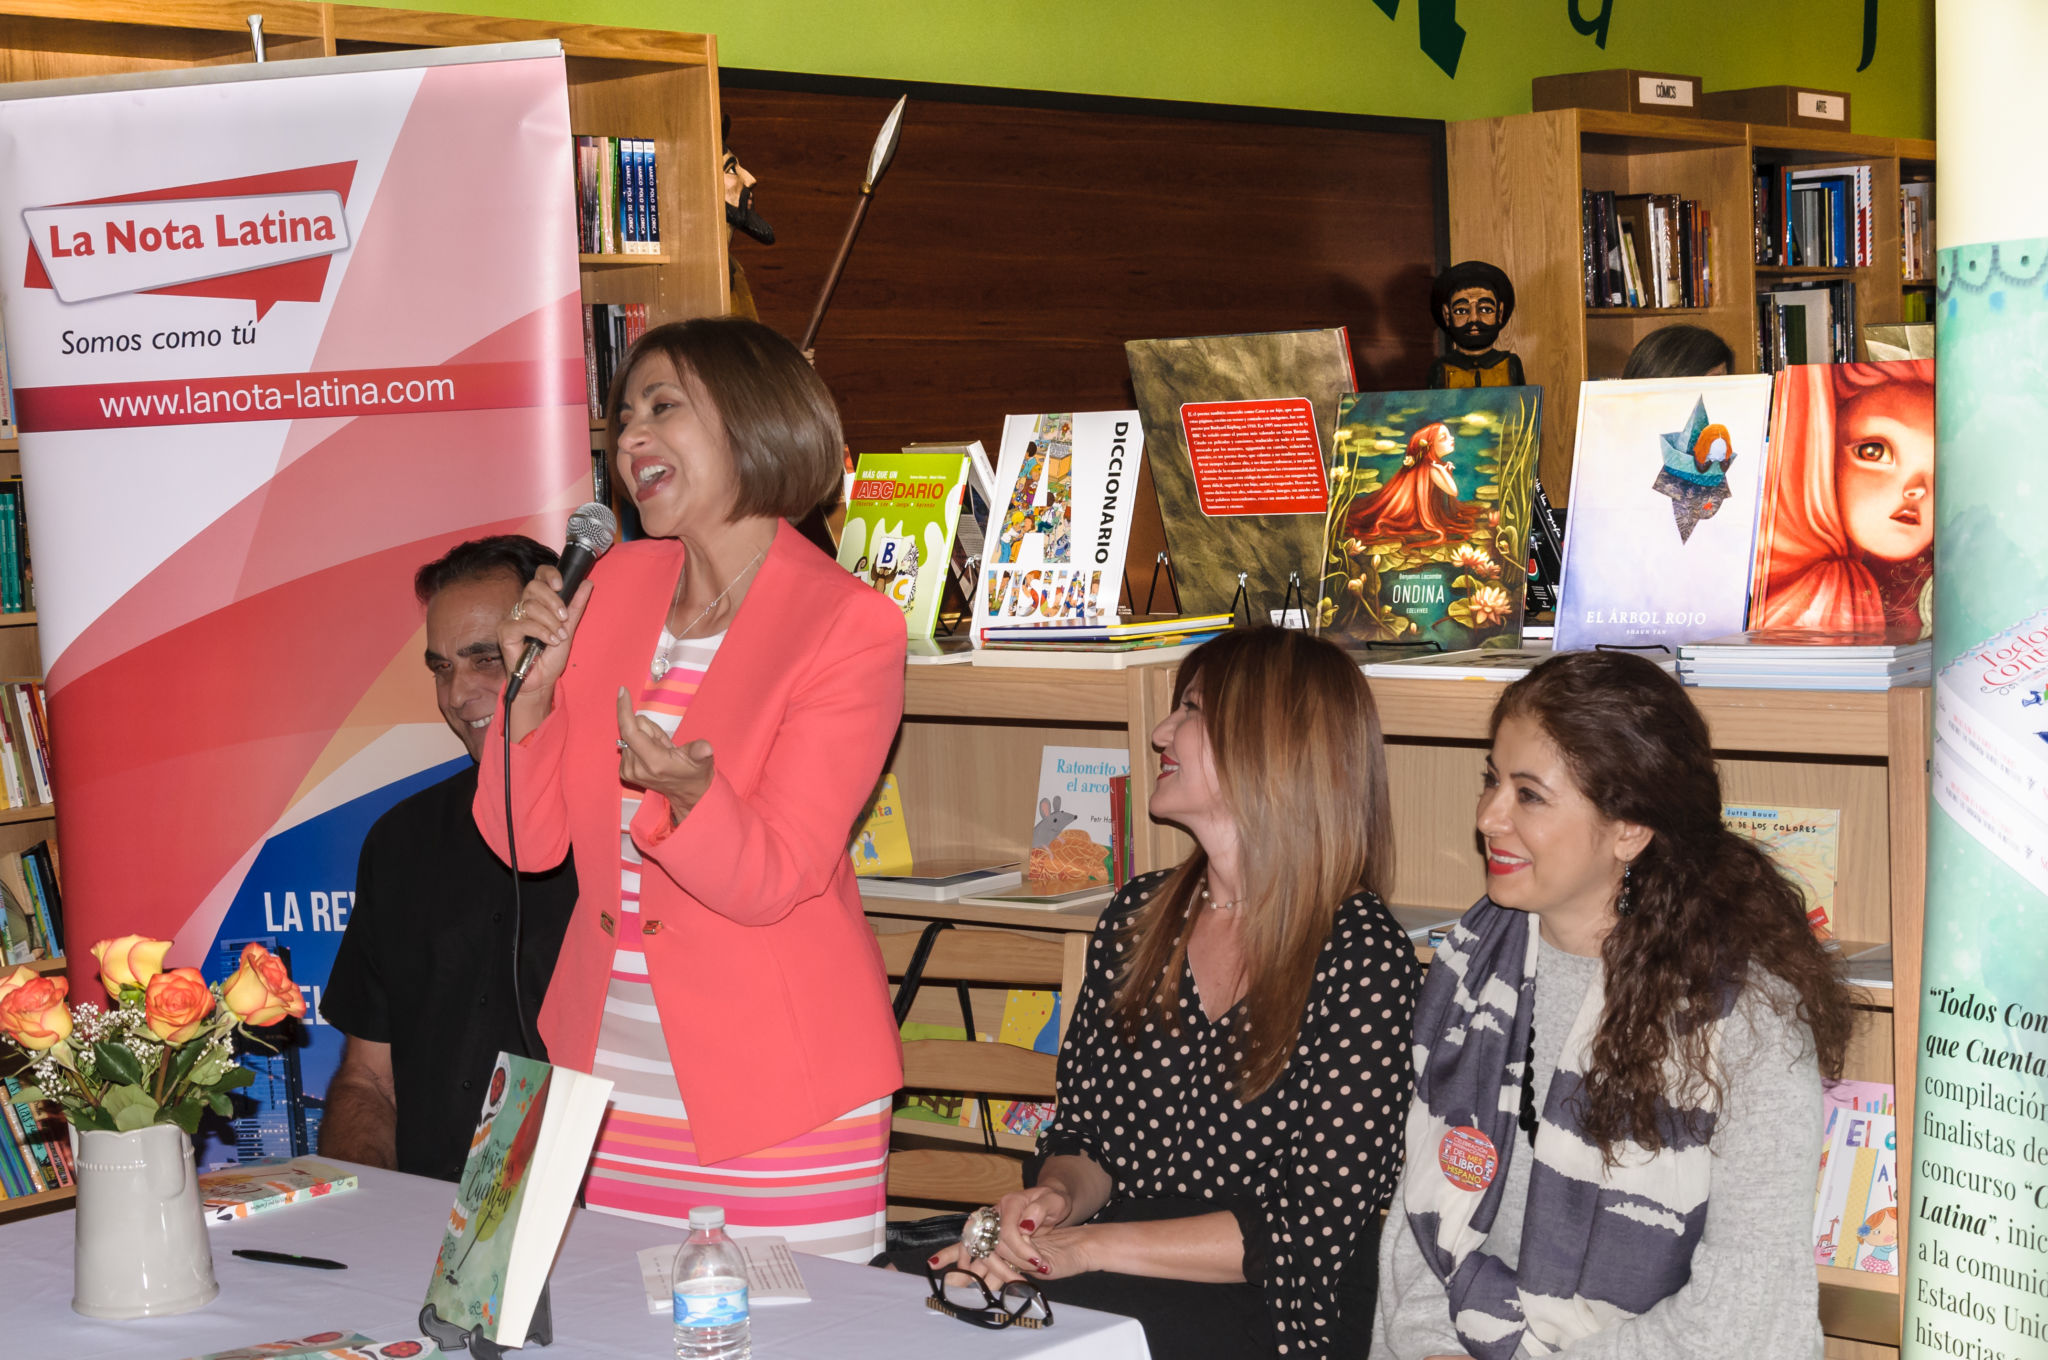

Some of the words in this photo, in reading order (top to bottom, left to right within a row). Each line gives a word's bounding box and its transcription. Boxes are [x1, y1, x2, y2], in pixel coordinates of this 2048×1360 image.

[1656, 82, 1677, 99] CÓMICS
[1815, 100, 1828, 114] ARTE
[49, 224, 95, 258] La
[106, 215, 204, 254] Nota
[216, 209, 335, 249] Latina
[61, 327, 142, 355] Somos
[152, 324, 221, 351] como
[232, 319, 257, 345] tú
[99, 372, 456, 420] www.lanota-latina.com
[862, 469, 875, 479] MÁS
[876, 470, 888, 480] QUE
[888, 470, 898, 480] UN
[857, 481, 944, 500] ABCDARIO
[1095, 421, 1129, 564] DICCIONARIO
[988, 570, 1105, 618] VISUAL
[1392, 584, 1445, 603] ONDINA
[1585, 610, 1604, 624] EL
[1608, 607, 1660, 625] ÁRBOL
[1664, 611, 1707, 627] ROJO
[1056, 758, 1117, 776] Ratoncito
[1066, 777, 1078, 793] el
[1726, 809, 1748, 817] Jutta
[1752, 809, 1777, 818] Bauer
[1738, 821, 1747, 829] DE
[1751, 821, 1767, 831] LOS
[1773, 822, 1817, 833] COLORES
[264, 891, 304, 932] LA
[1929, 987, 1998, 1024] “Todos
[1926, 1034, 1960, 1058] que
[1966, 1038, 2048, 1079] Cuenta
[1846, 1119, 1872, 1148] El
[1923, 1110, 2016, 1158] finalistas
[1453, 1147, 1466, 1158] DEL
[1466, 1154, 1483, 1165] MES
[1453, 1155, 1484, 1176] LIBRO
[1446, 1165, 1482, 1184] HISPANO
[1921, 1158, 2016, 1201] concurso
[1919, 1195, 2000, 1244] Latina”,
[1918, 1242, 1928, 1262] a
[1933, 1239, 1950, 1269] la
[1917, 1278, 1996, 1326] Estados
